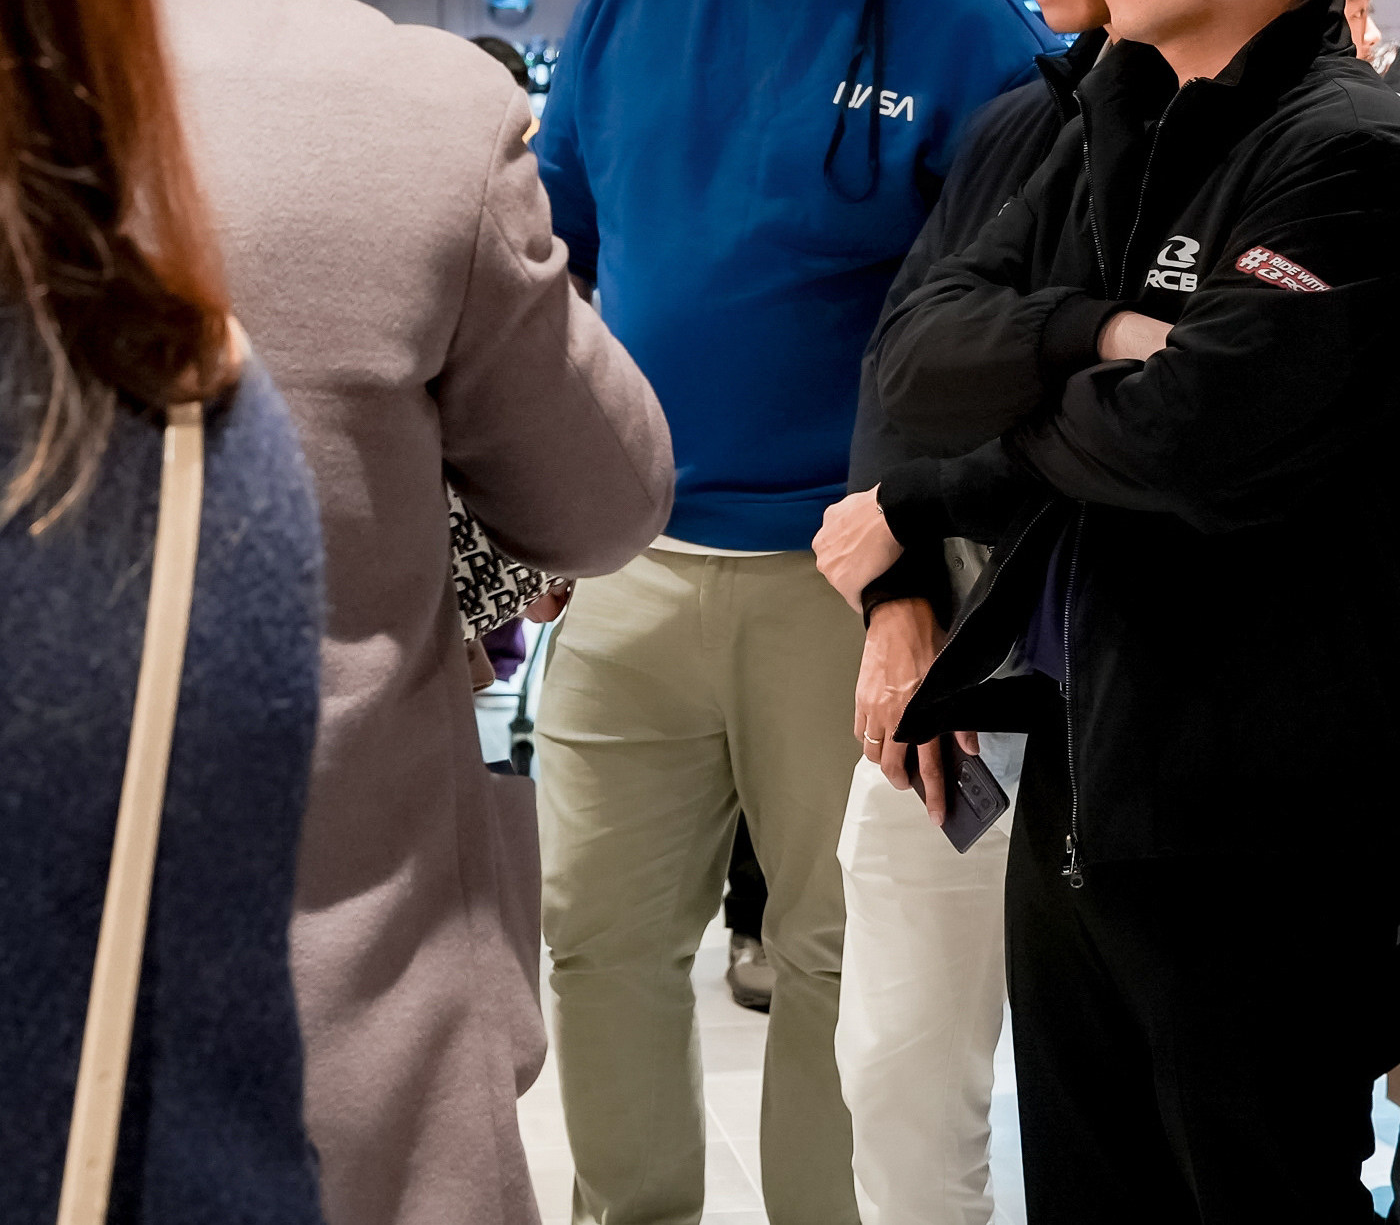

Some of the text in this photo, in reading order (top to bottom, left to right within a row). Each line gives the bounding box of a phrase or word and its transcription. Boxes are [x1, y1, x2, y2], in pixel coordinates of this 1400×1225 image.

[1268, 256, 1301, 275] RIDE
[1144, 269, 1198, 292] RCB
[1280, 276, 1310, 291] RC
